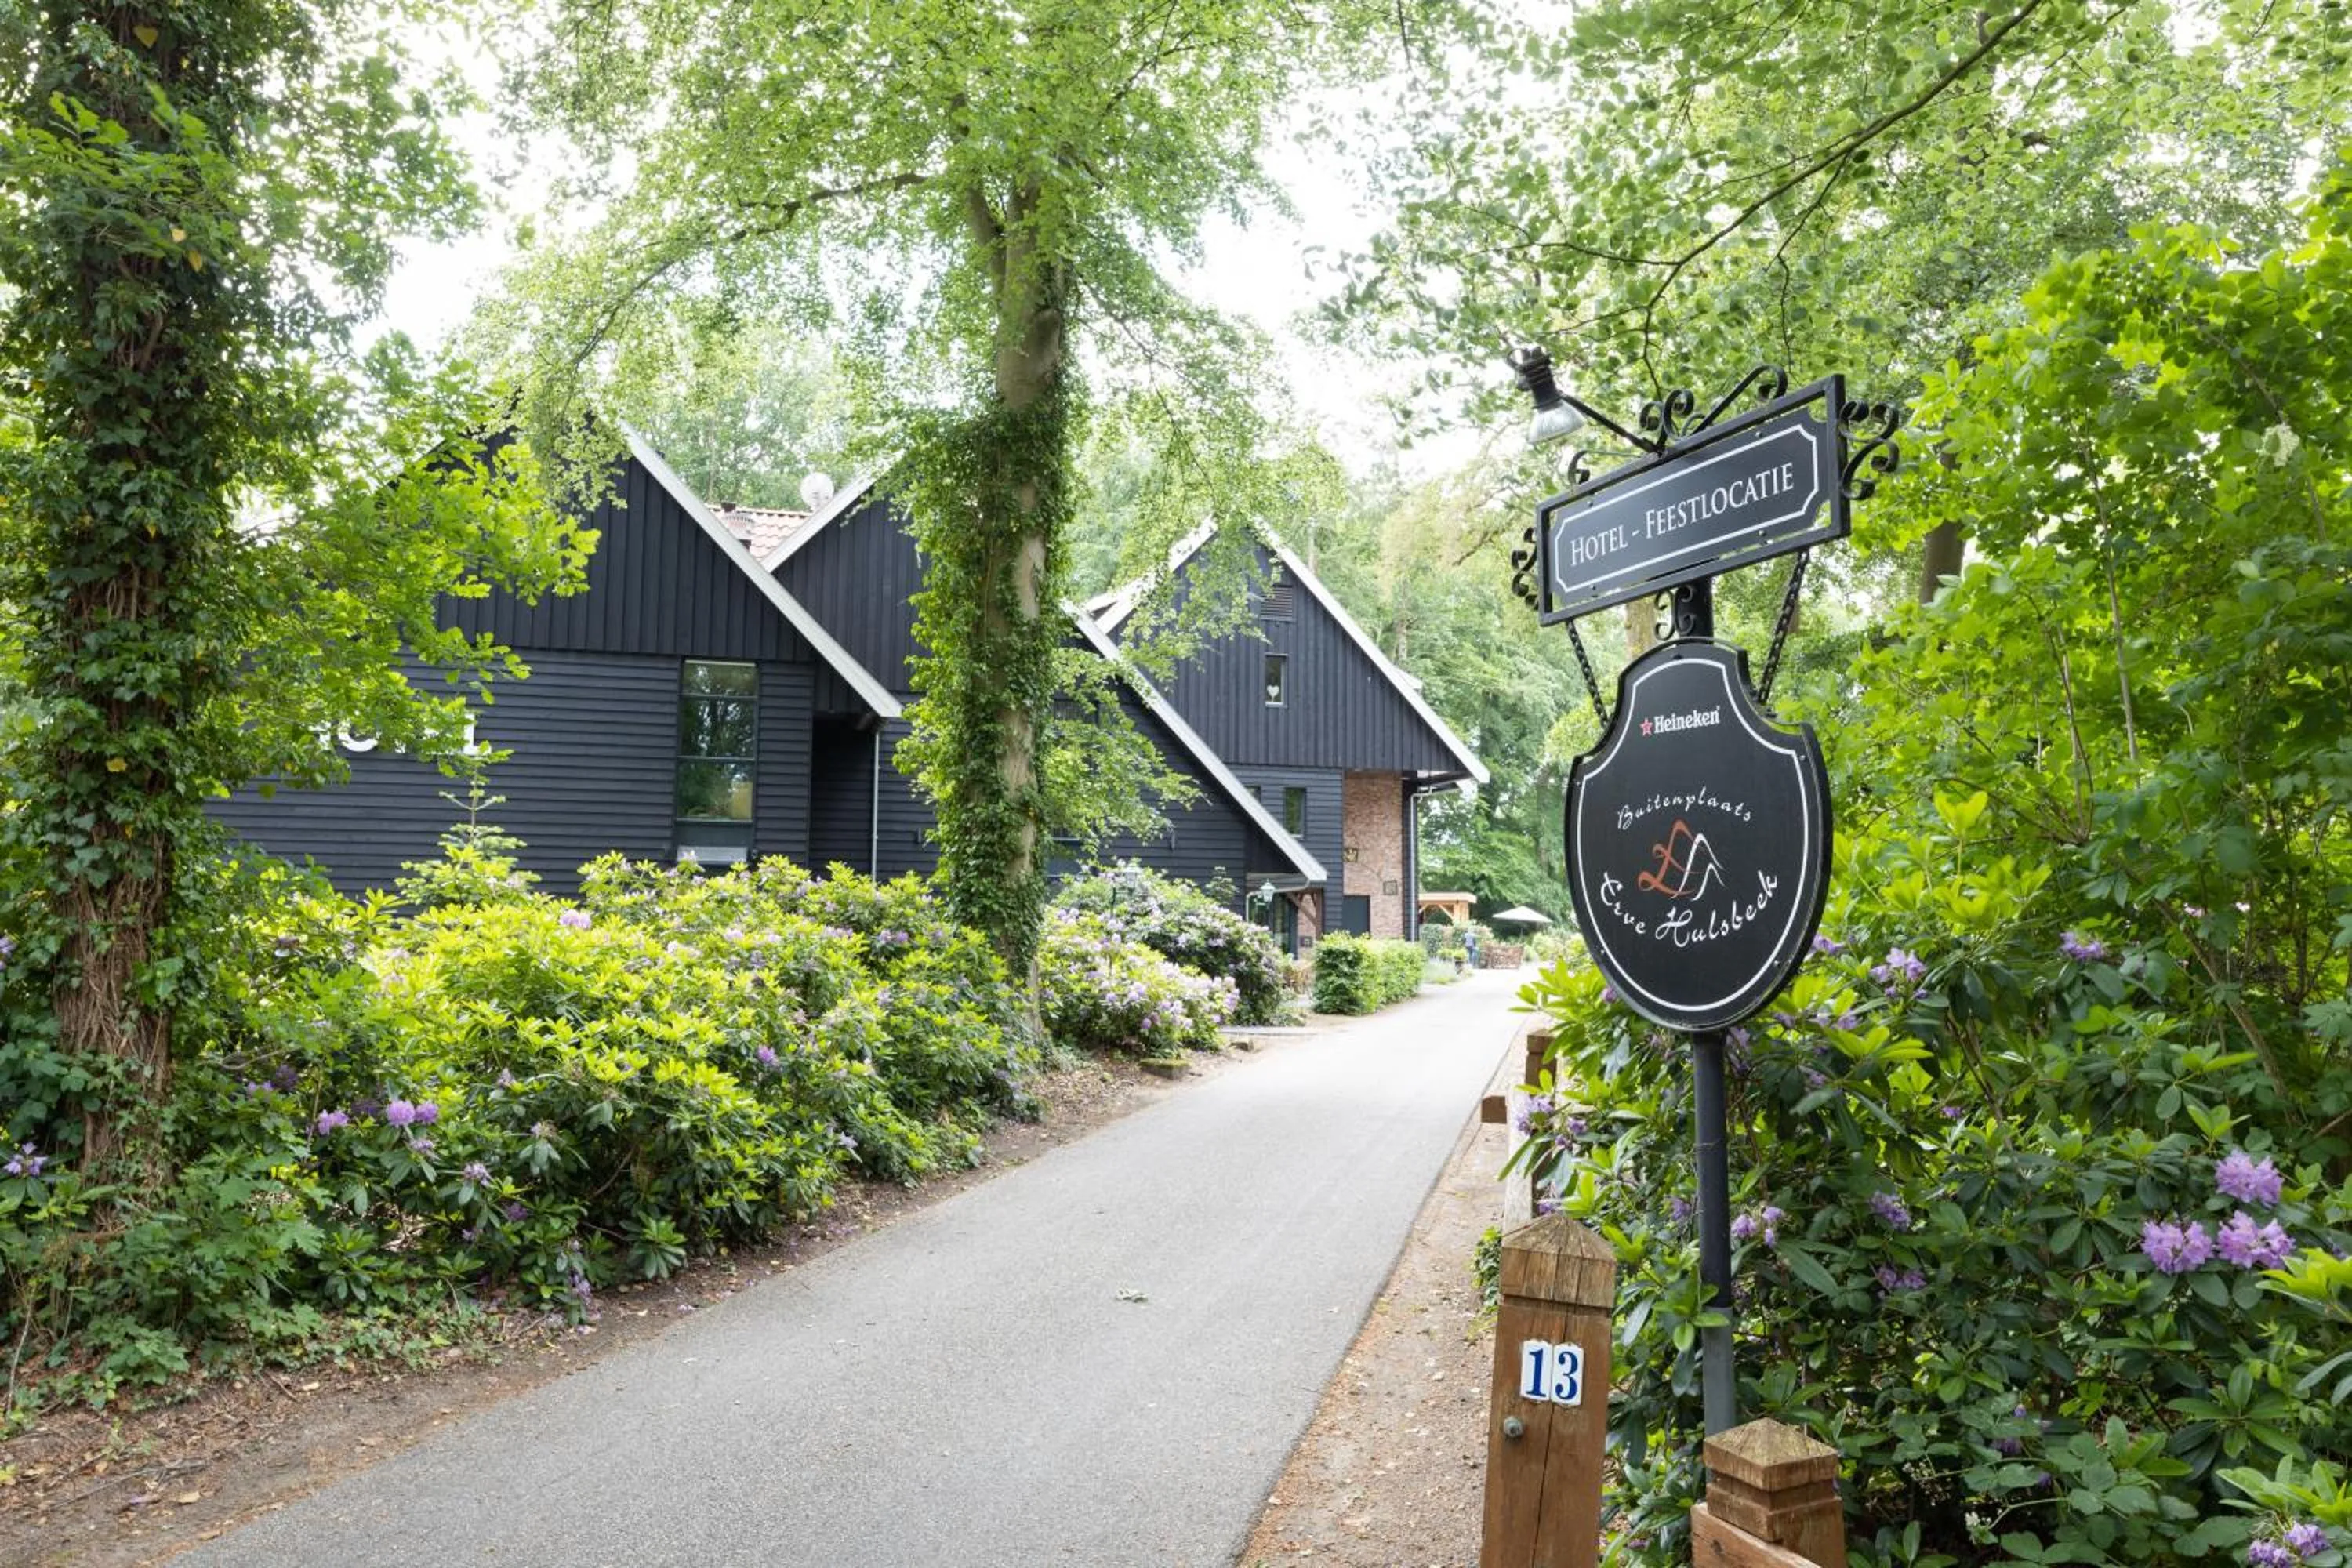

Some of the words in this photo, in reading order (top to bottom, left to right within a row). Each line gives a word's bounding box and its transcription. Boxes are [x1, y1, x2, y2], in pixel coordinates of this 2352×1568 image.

[1570, 525, 1628, 566] HOTEL
[1646, 462, 1795, 539] FEESTLOCATIE
[1653, 710, 1720, 734] Heineken
[1617, 786, 1751, 829] Buitenplaats
[1655, 870, 1777, 947] Hulsbeek
[1526, 1348, 1578, 1400] 13
